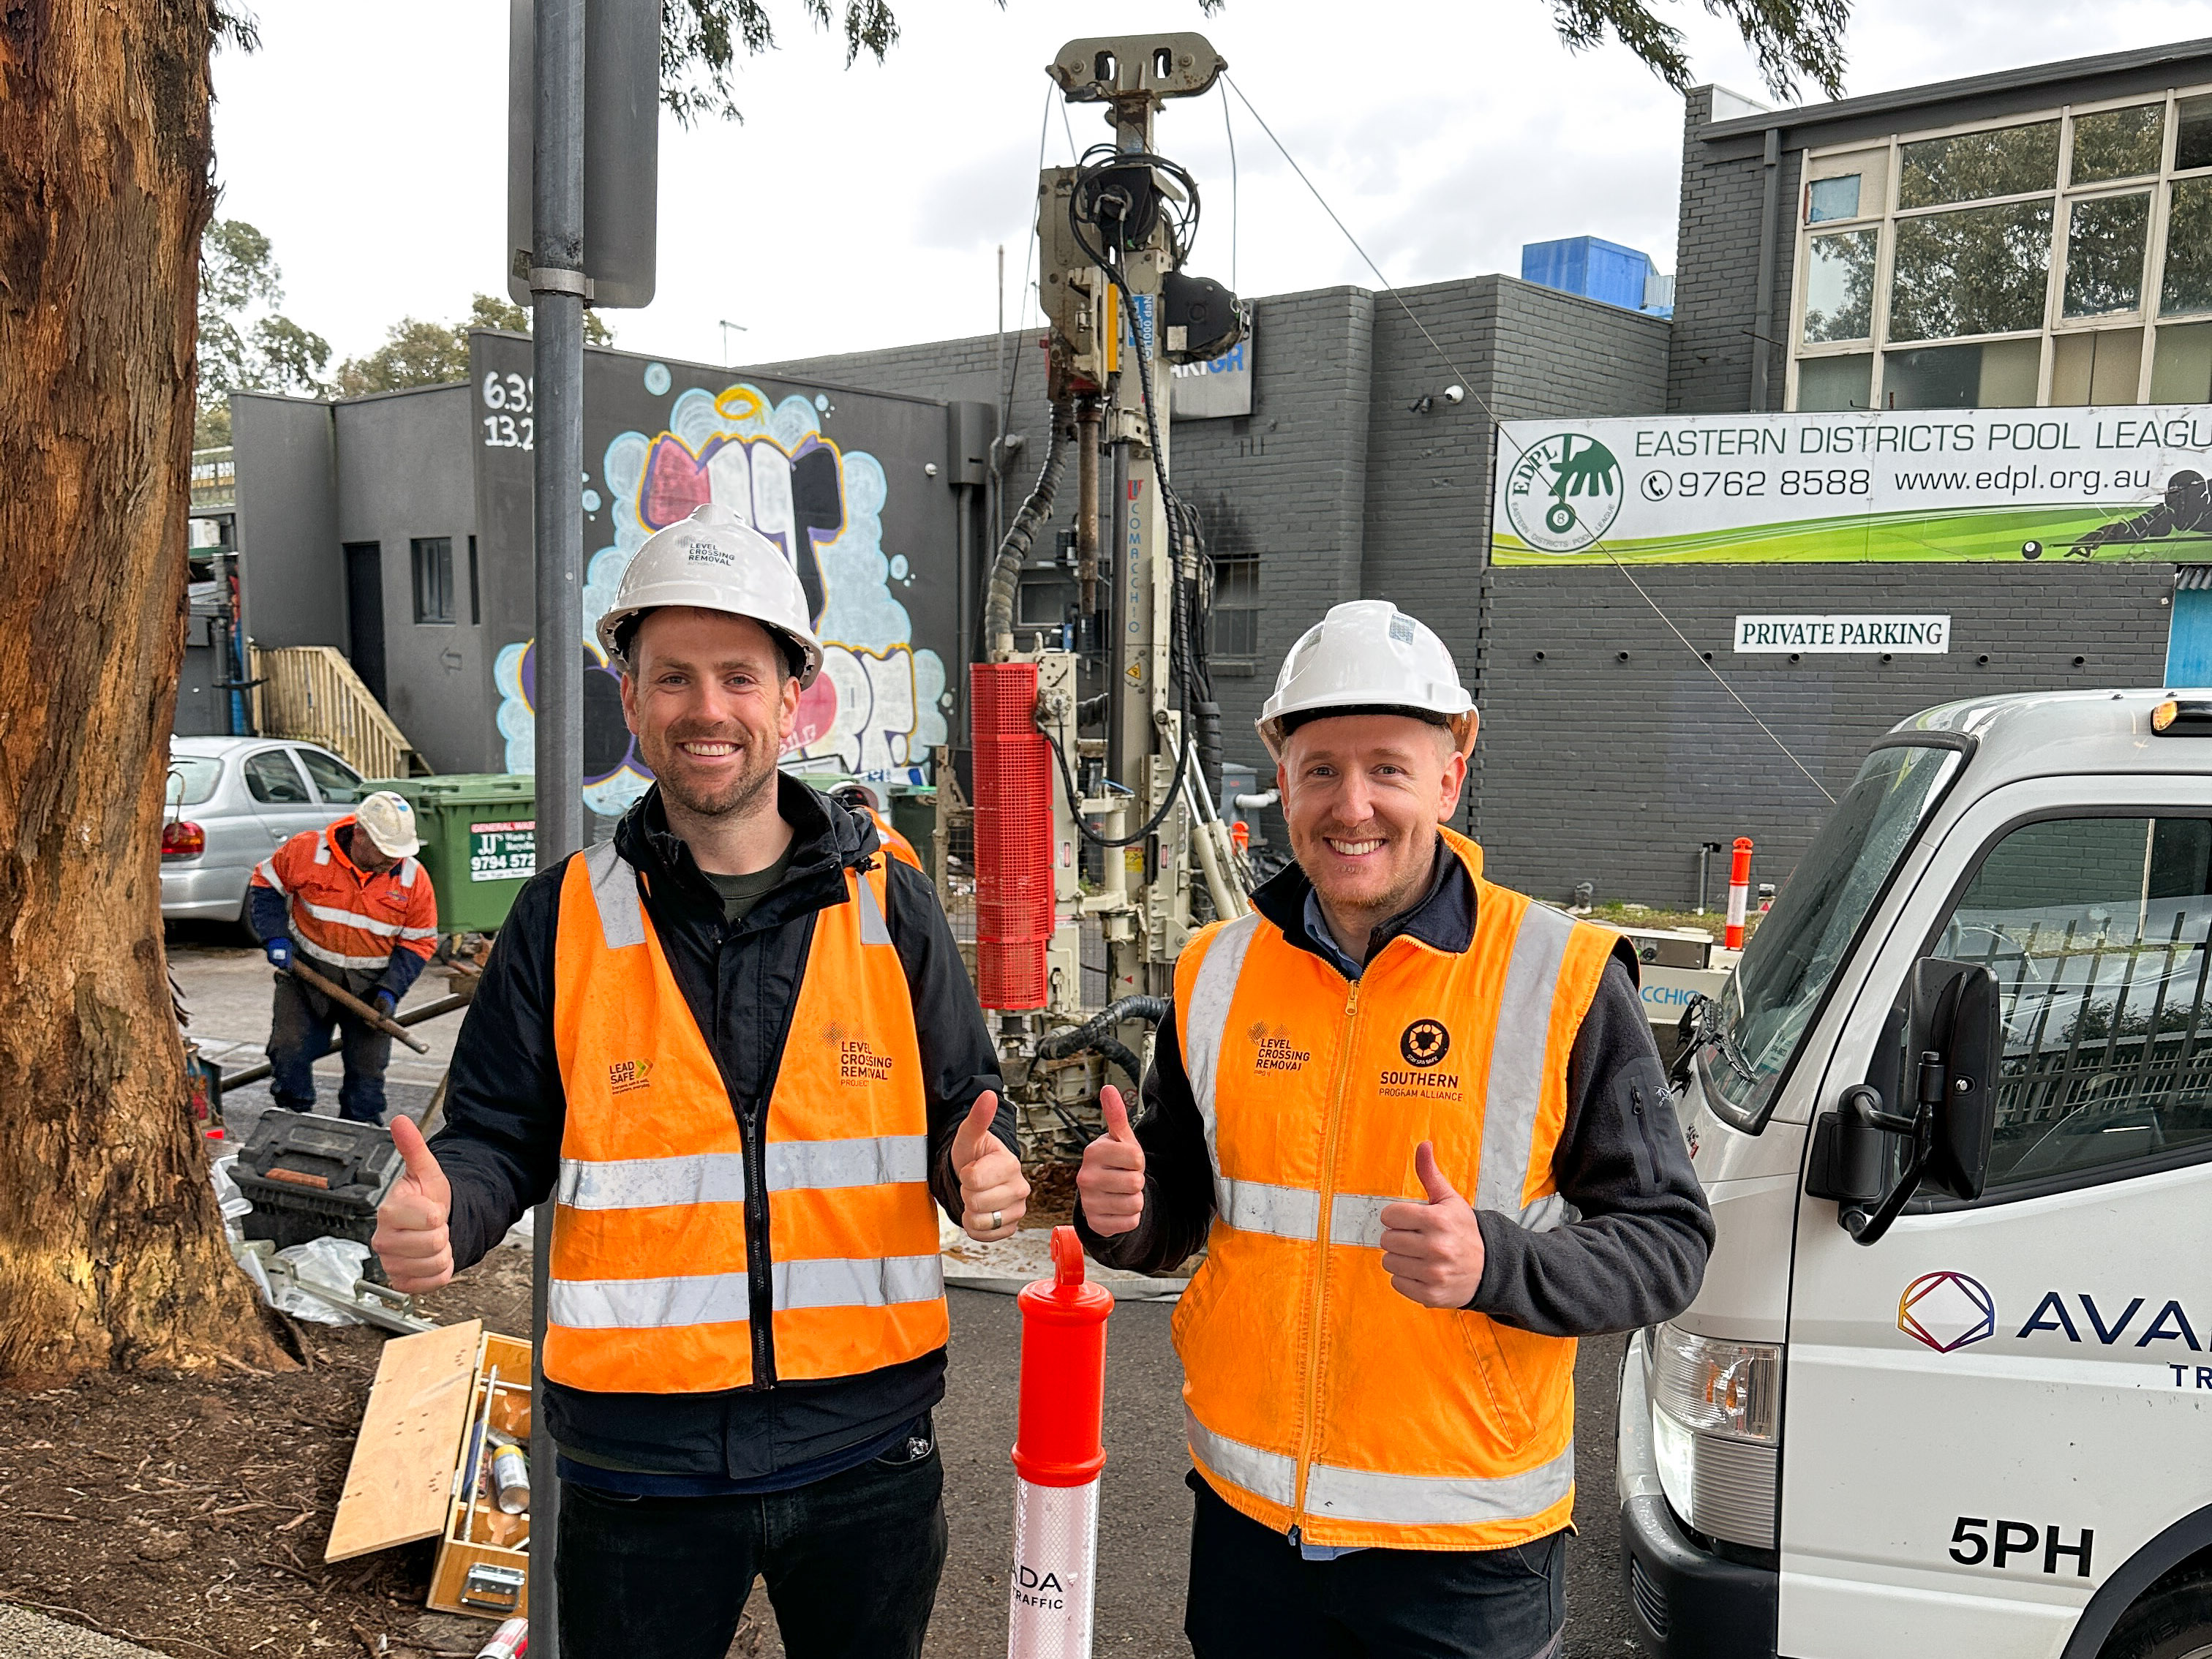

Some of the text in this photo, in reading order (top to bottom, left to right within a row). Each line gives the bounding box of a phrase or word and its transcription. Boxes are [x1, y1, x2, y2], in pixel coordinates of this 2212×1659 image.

[1636, 427, 1786, 457] EASTERN
[1800, 424, 1974, 454] DISTRICTS
[1988, 422, 2080, 451] POOL
[1512, 444, 1558, 497] EDPL
[1678, 464, 2151, 497] 9762 8588 www.edpl.org.au
[689, 549, 735, 560] CROSSING
[690, 543, 718, 551] LEVEL
[688, 554, 731, 566] REMOVAL
[1128, 503, 1141, 633] COMACCHIO
[1741, 622, 1943, 644] PRIVATE PARKING
[470, 854, 508, 871] 9794
[841, 1041, 873, 1055] LEVEL
[1260, 1038, 1292, 1050] LEVEL
[840, 1054, 892, 1069] CROSSING
[1258, 1048, 1310, 1062] CROSSING
[609, 1061, 634, 1074] LEAD
[611, 1071, 635, 1084] SAFE
[1380, 1071, 1459, 1089] SOUTHERN
[1420, 1089, 1464, 1102] ALLIANCE
[2015, 1291, 2212, 1353] AVA
[1948, 1516, 2095, 1579] 5PH
